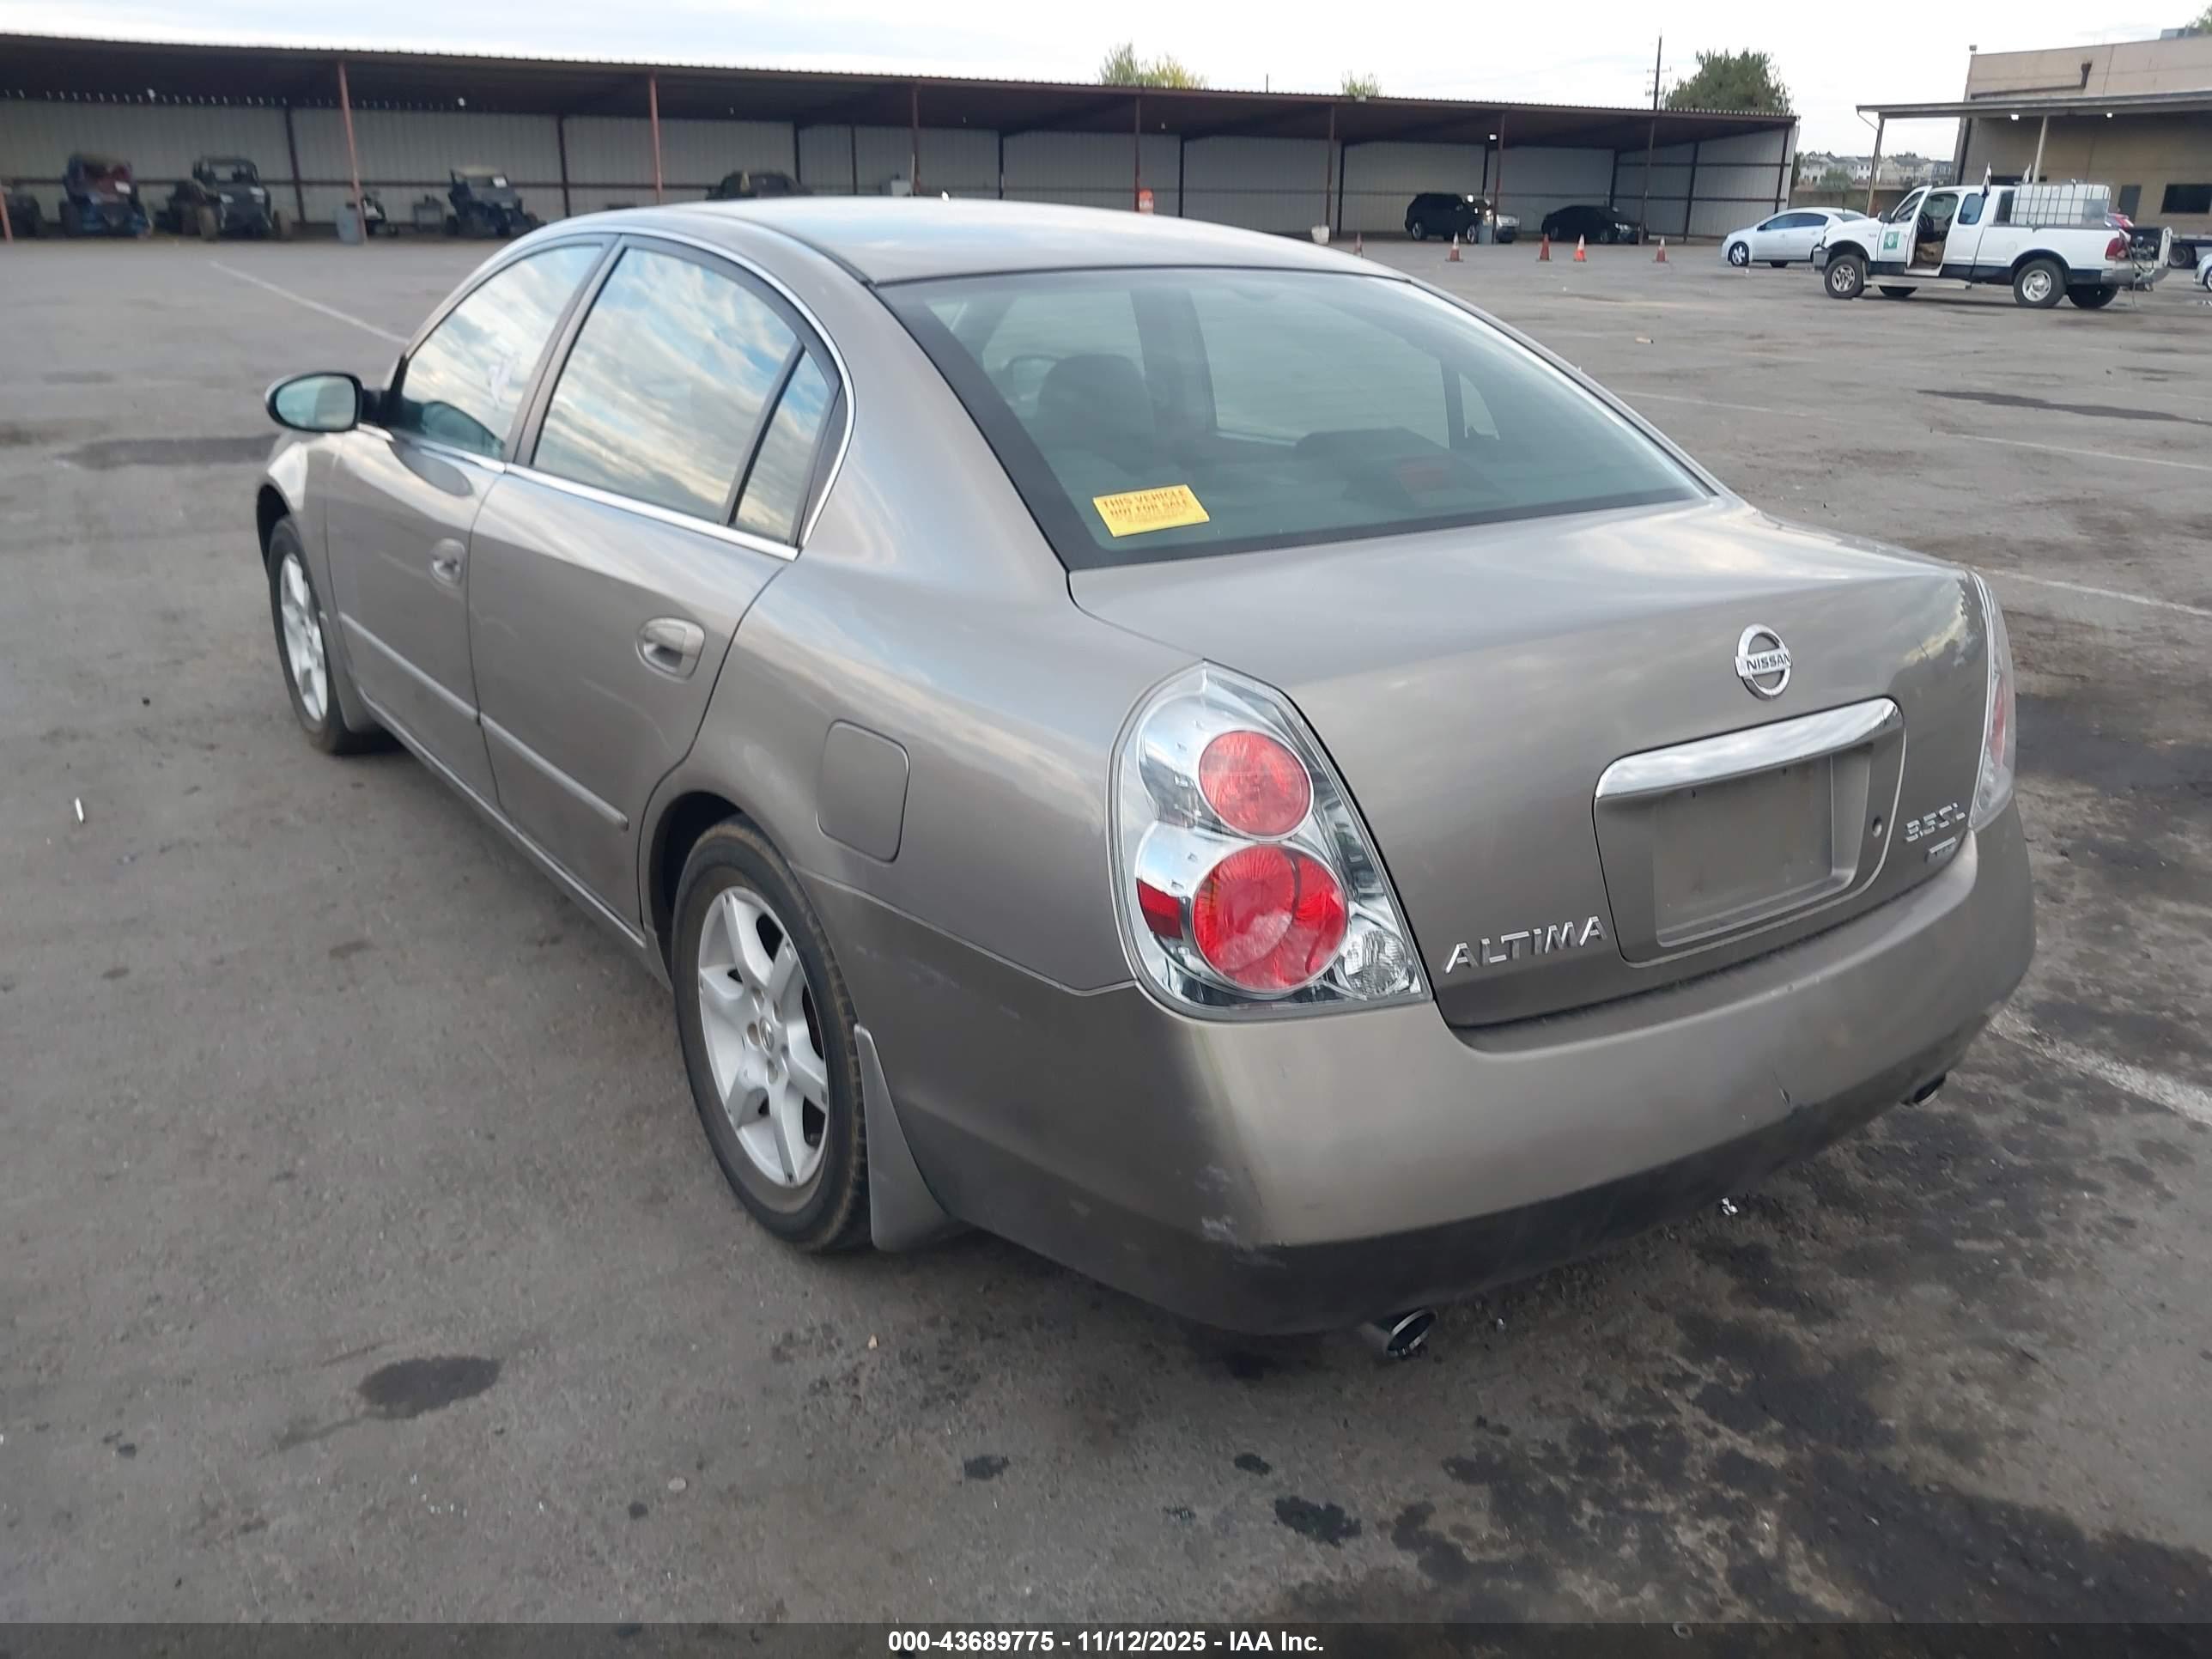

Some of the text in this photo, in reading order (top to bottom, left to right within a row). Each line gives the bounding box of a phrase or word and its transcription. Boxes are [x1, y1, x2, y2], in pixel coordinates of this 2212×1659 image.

[1103, 489, 1187, 509] THIS VEHICLE
[1109, 507, 1133, 517] NOT
[1136, 503, 1159, 514] FOR
[1162, 499, 1187, 510] SALE
[1746, 653, 1791, 672] NISSAN
[1444, 915, 1608, 974] ALTIMA
